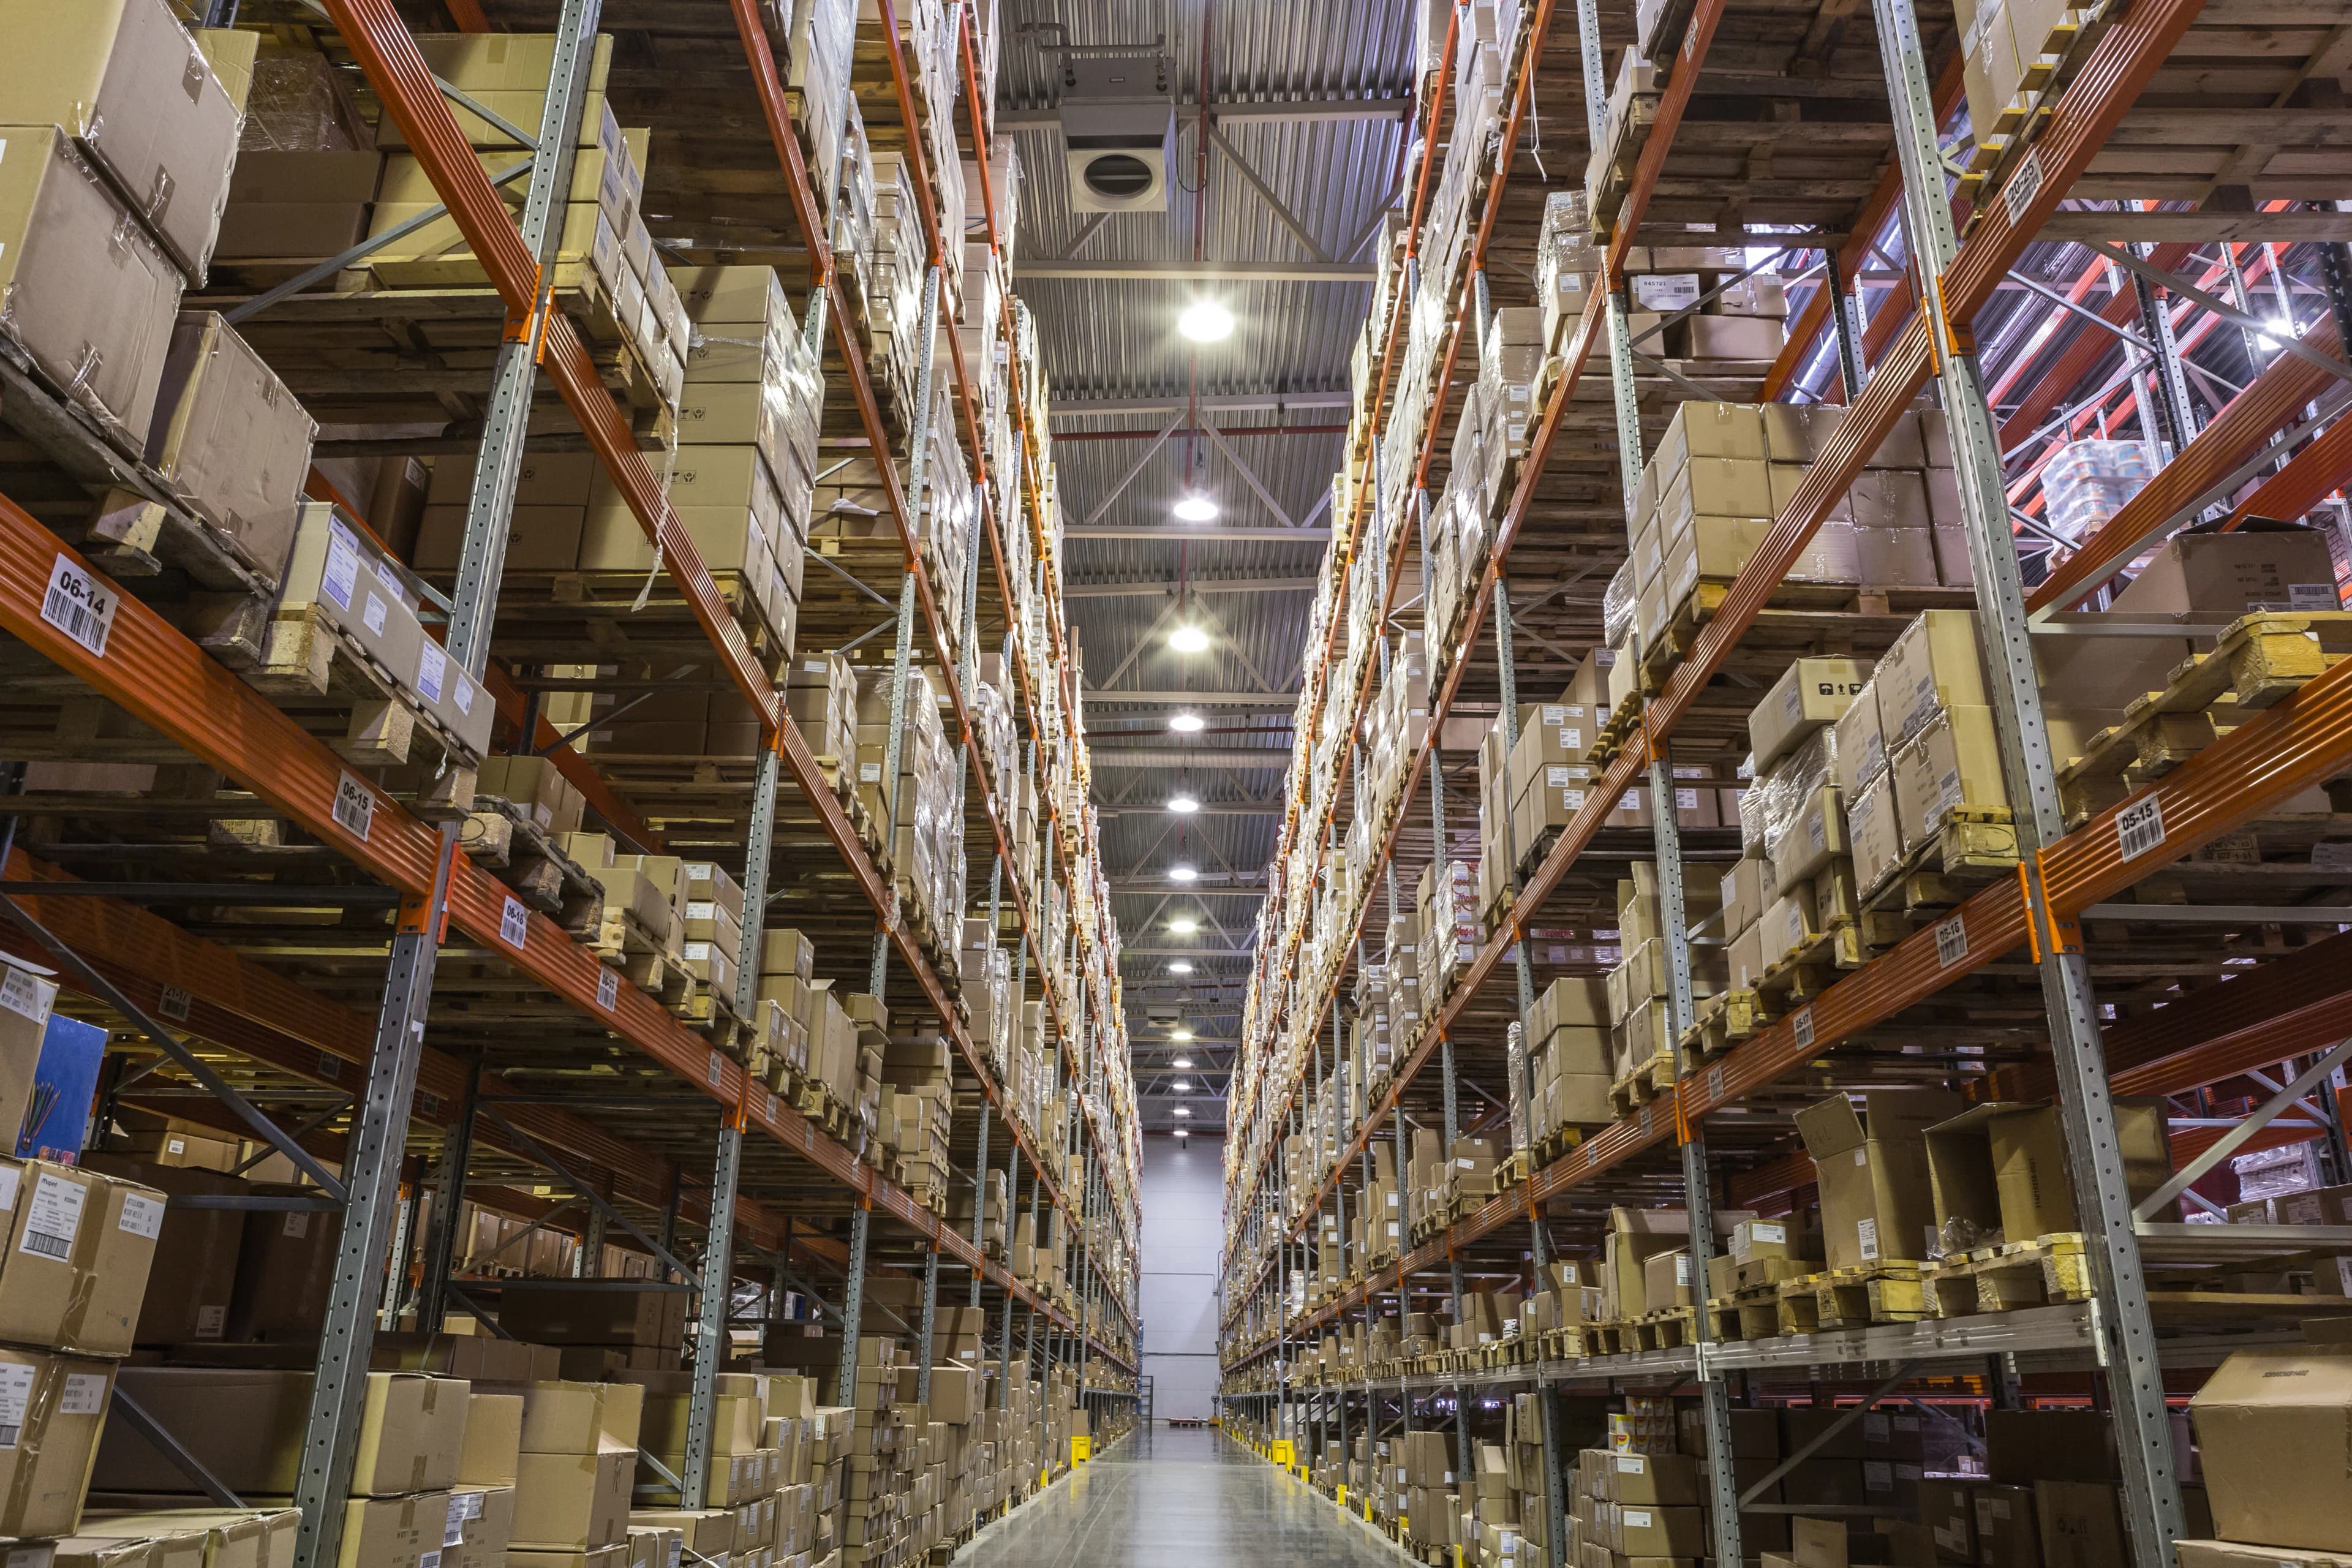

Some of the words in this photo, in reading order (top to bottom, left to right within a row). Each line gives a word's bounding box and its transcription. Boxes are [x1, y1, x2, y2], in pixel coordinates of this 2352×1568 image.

[2009, 160, 2034, 202] 20-25
[60, 571, 105, 616] 06-14
[343, 782, 369, 810] 06-15
[2122, 803, 2153, 831] 05-15
[507, 905, 524, 925] 06-16
[1939, 921, 1959, 942] 05-16
[1796, 1014, 1809, 1030] 05-17
[42, 1178, 58, 1188] Maped
